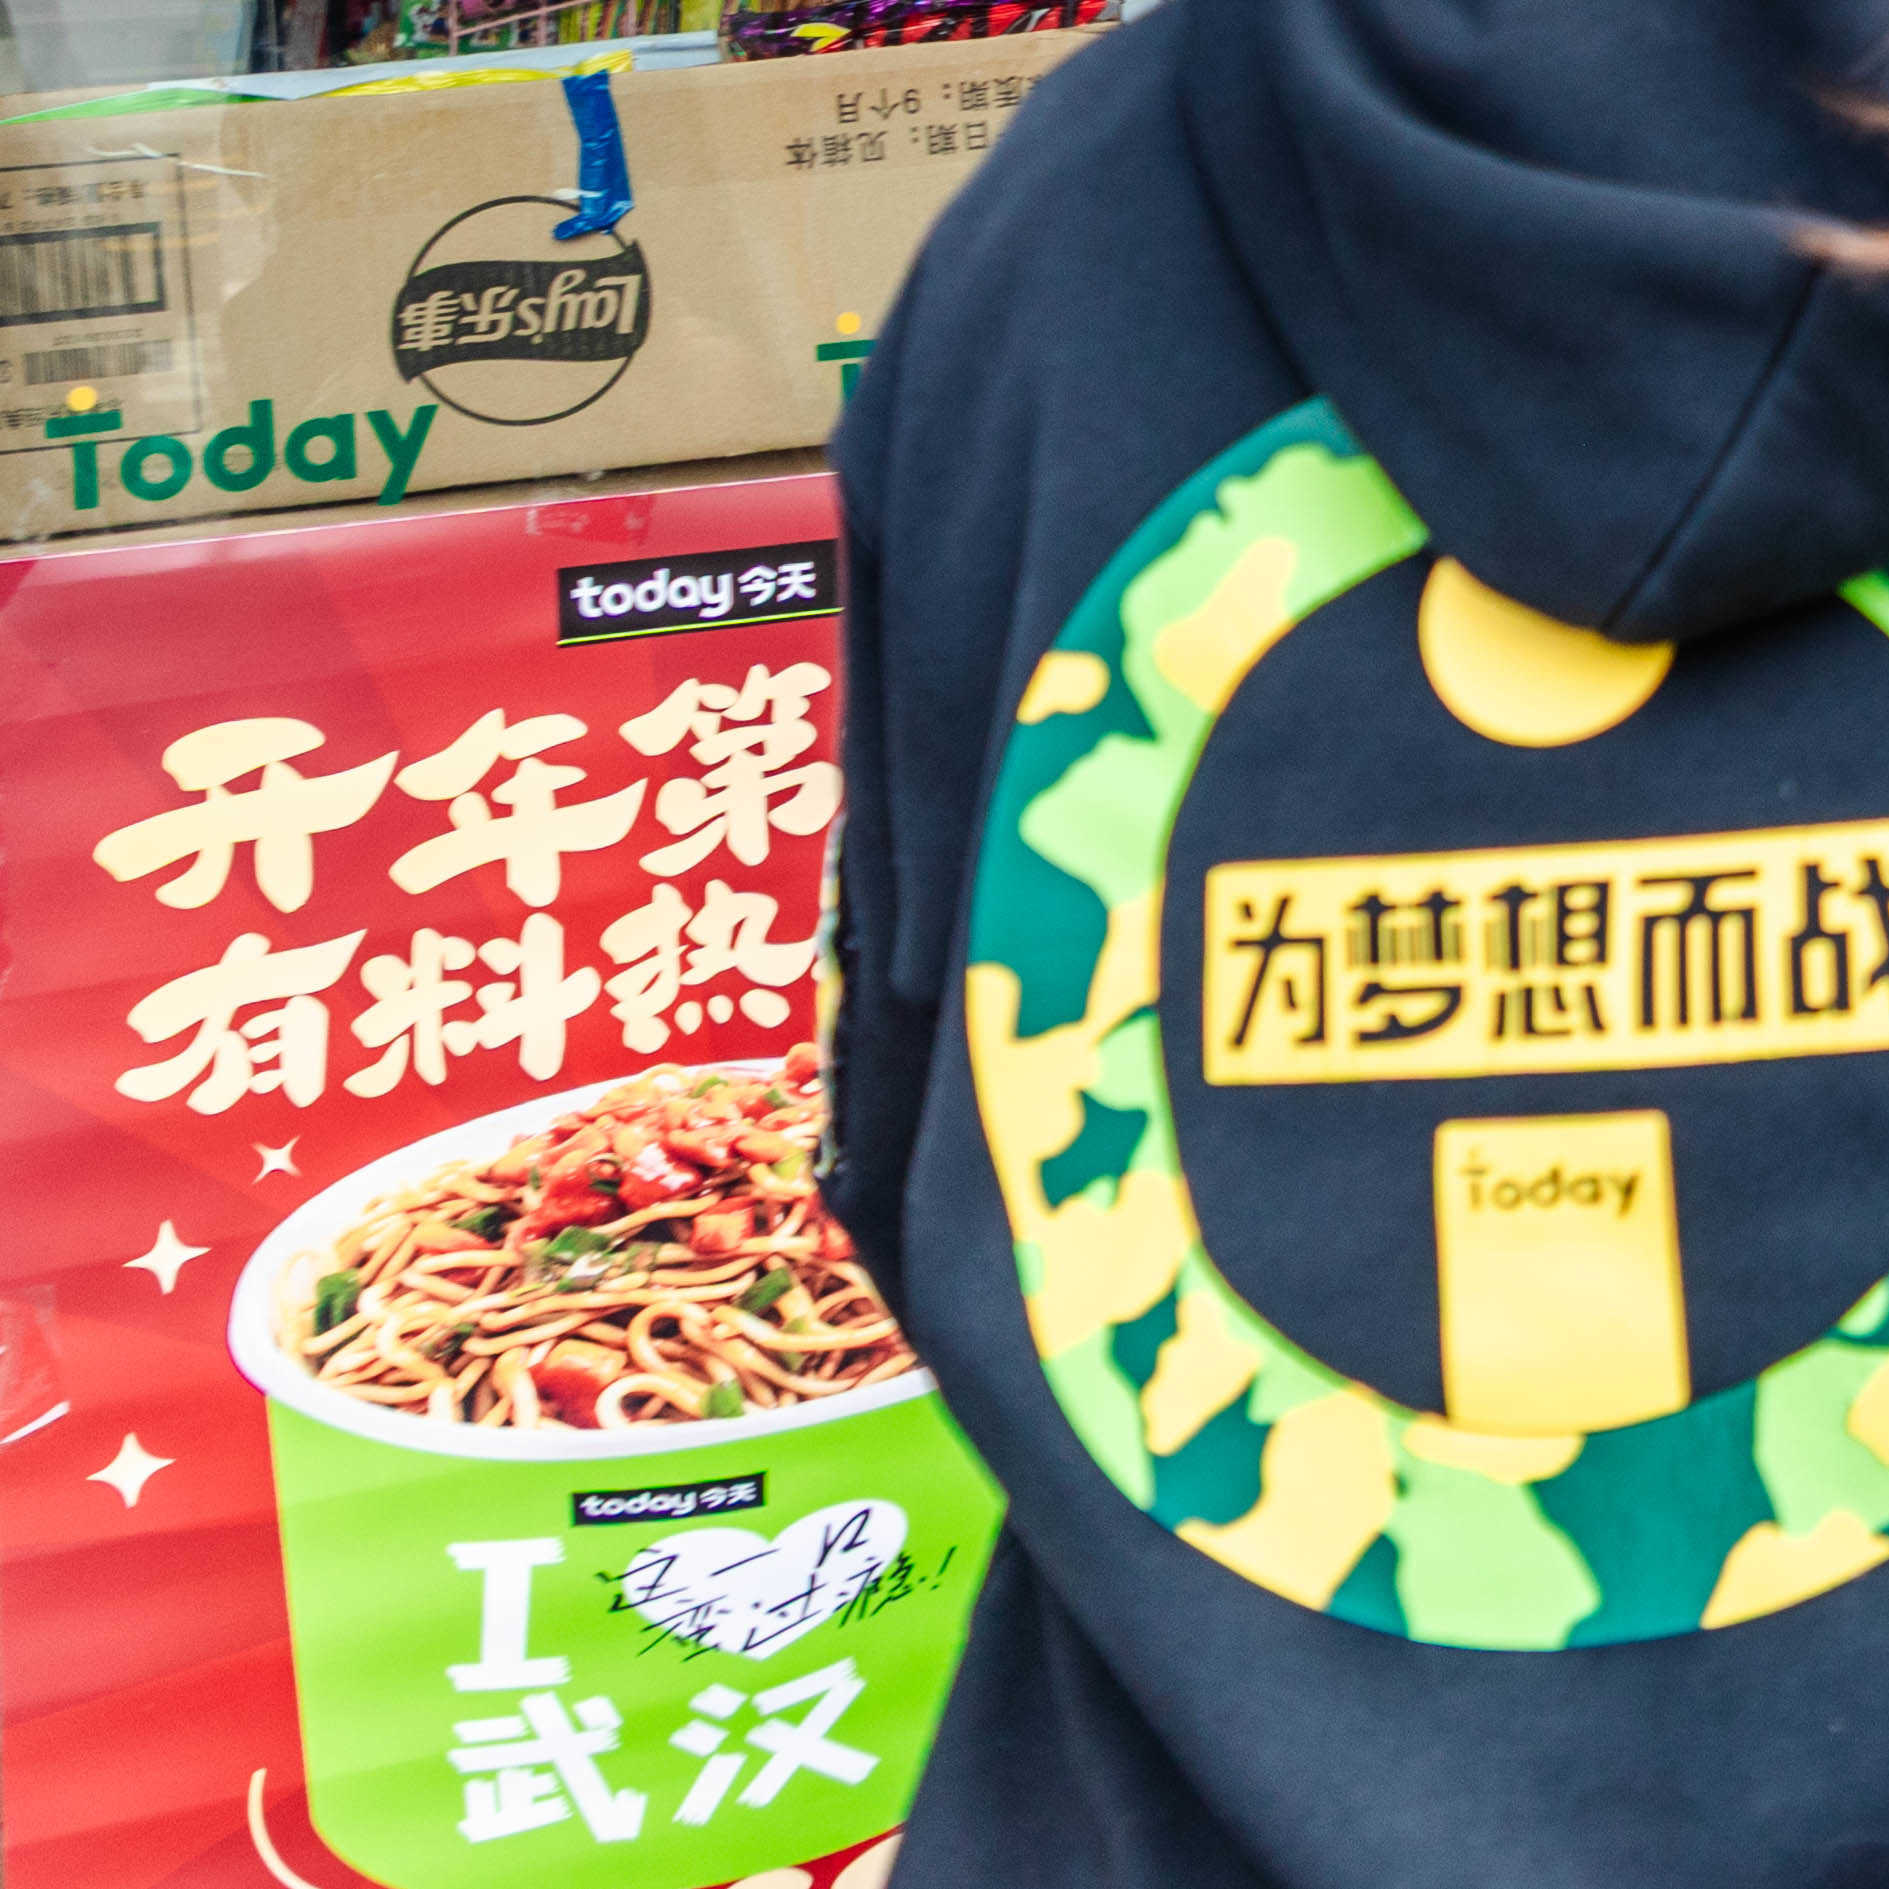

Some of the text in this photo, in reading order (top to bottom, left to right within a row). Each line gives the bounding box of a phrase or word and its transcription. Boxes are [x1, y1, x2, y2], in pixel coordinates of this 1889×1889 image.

[836, 72, 1044, 125] 质期：9个月
[46, 398, 438, 511] Today
[1460, 1142, 1643, 1218] Today
[446, 1656, 882, 1844] 武汉
